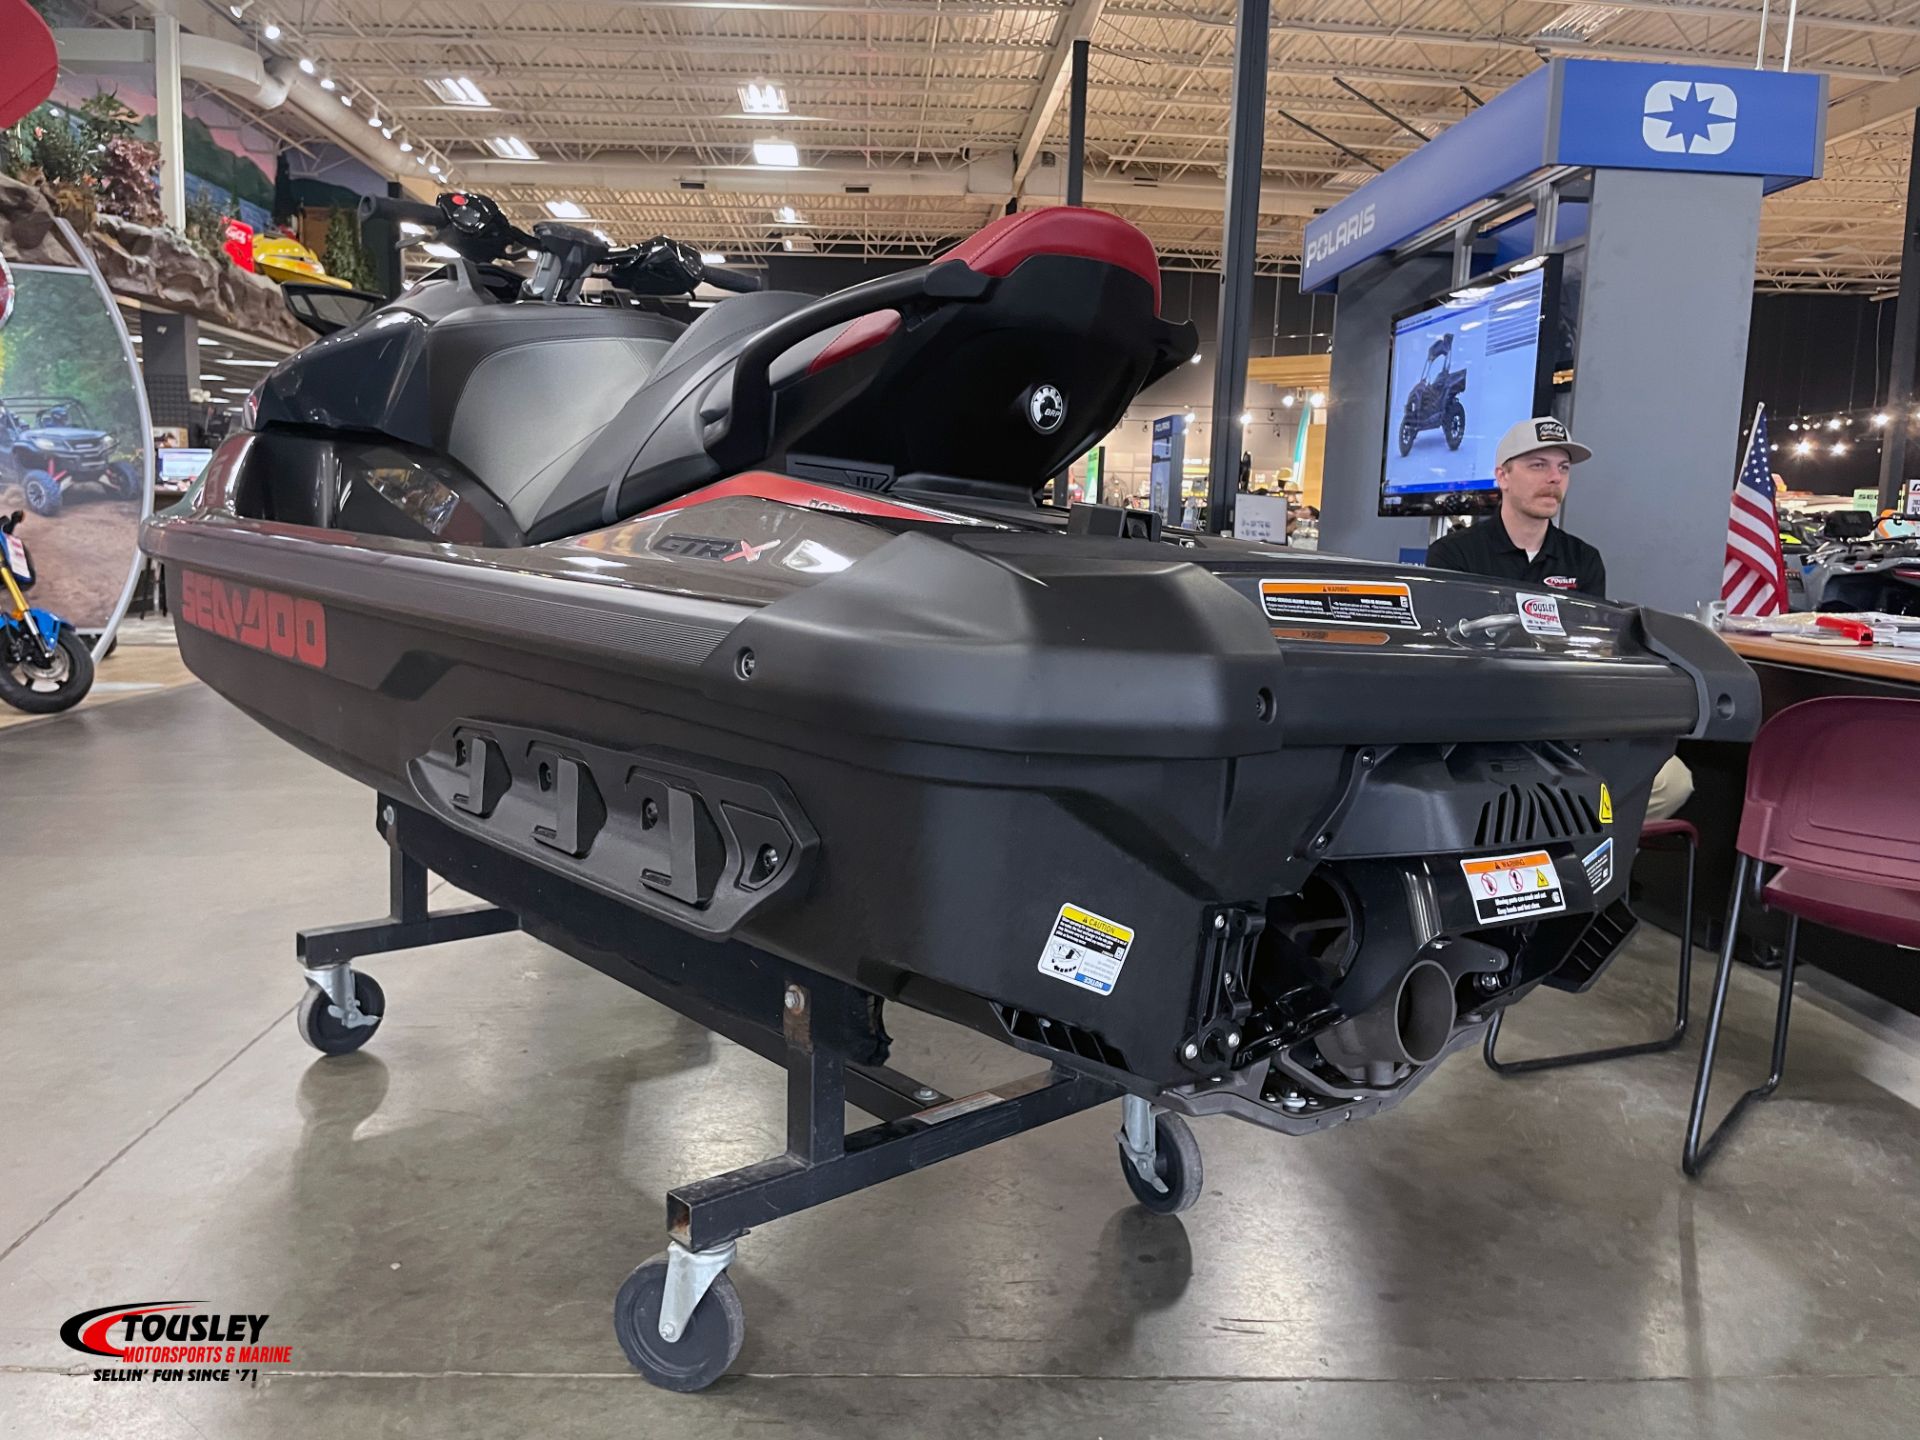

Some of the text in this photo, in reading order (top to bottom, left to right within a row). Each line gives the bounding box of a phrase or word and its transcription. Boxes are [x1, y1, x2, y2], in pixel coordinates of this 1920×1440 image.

[1306, 203, 1376, 268] POLARIS
[1045, 408, 1061, 417] BRP
[1502, 859, 1525, 868] WARNING
[1088, 918, 1115, 934] CAUTION
